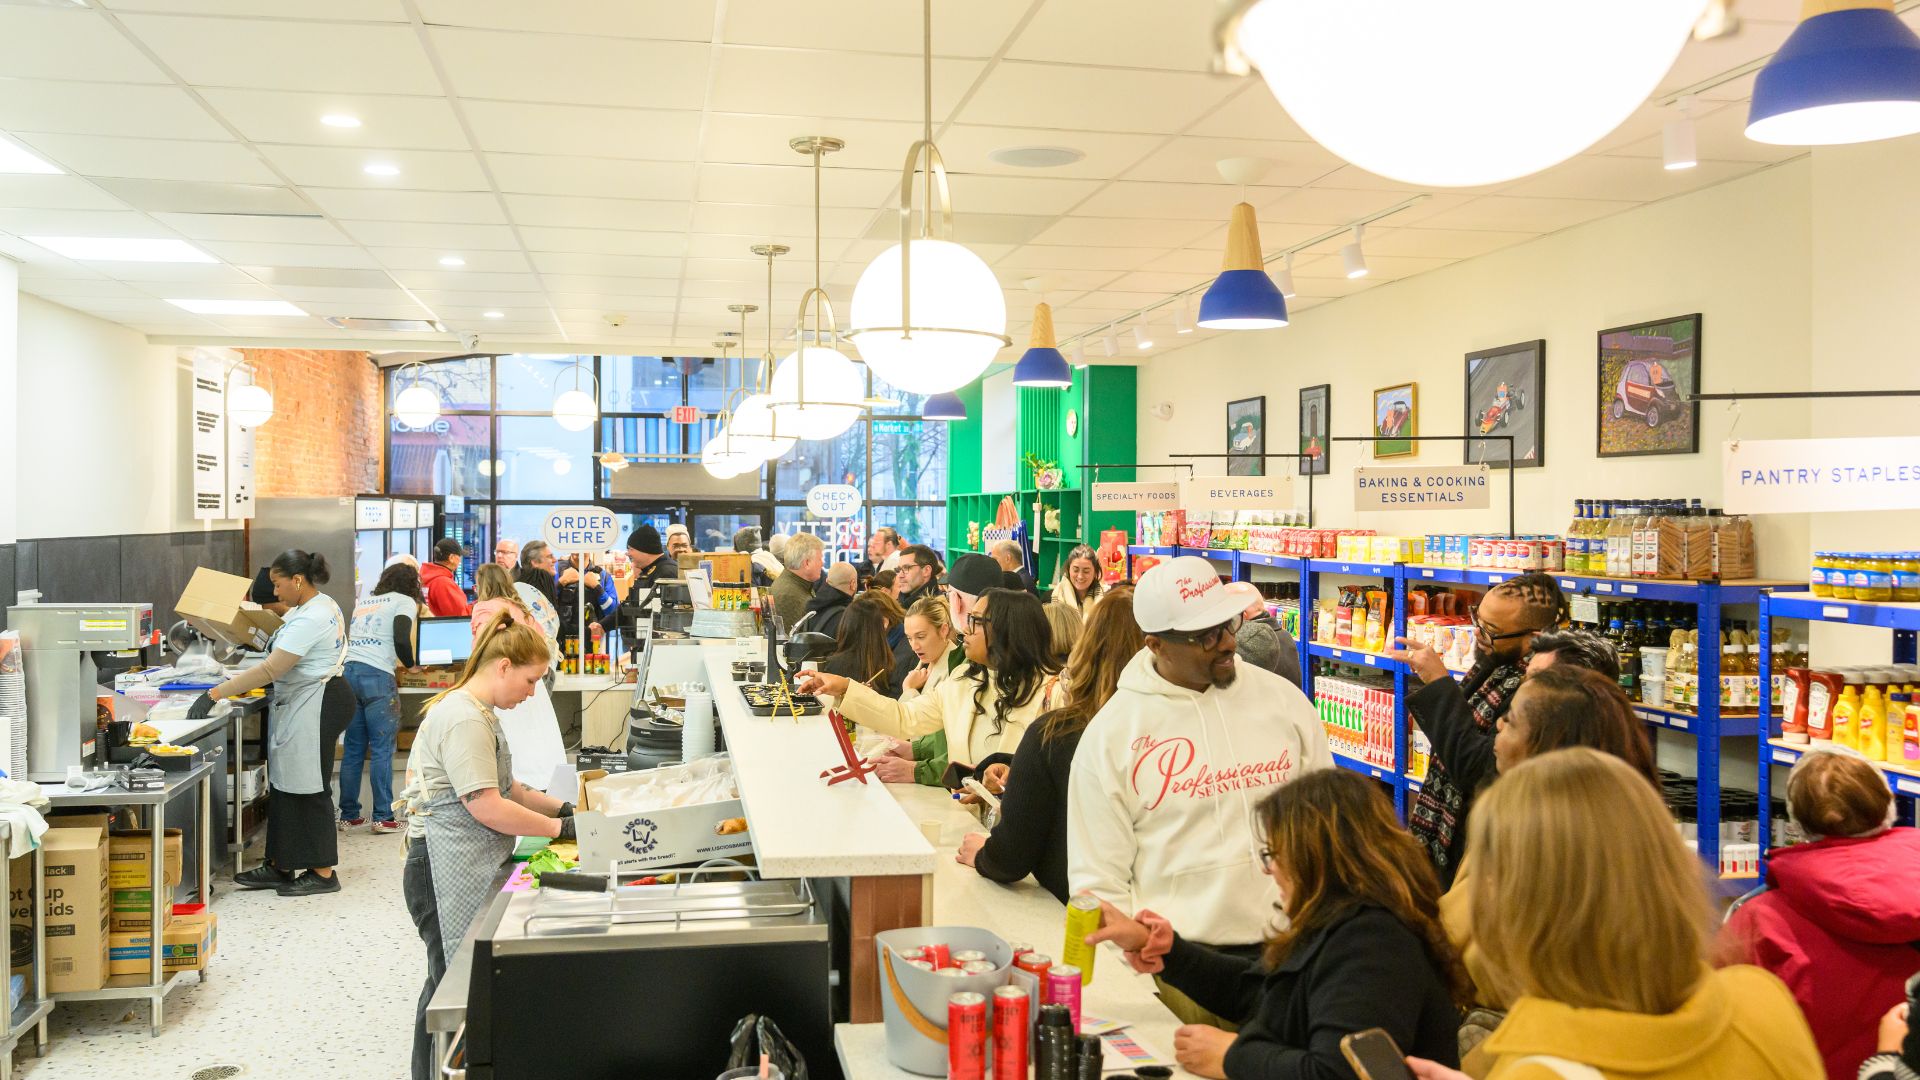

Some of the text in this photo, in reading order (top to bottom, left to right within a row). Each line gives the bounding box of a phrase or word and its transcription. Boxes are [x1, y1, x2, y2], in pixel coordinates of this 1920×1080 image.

[676, 407, 697, 423] EXIT
[879, 423, 901, 431] Market
[1359, 476, 1485, 488] BAKING & COOKING
[1741, 465, 1920, 486] PANTRY STAPLES
[814, 491, 854, 501] CHECK
[1096, 492, 1176, 500] SPECIALTY FOODS
[1210, 489, 1274, 498] BEVERAGES
[1381, 491, 1464, 503] ESSENTIALS
[822, 502, 847, 511] OUT
[551, 516, 612, 529] ORDER
[558, 531, 606, 544] HERE
[1175, 576, 1193, 588] The
[1131, 734, 1157, 752] The
[1132, 737, 1293, 811] Professionals
[1197, 772, 1290, 800] SERVICES, LLC
[622, 817, 659, 836] LISCIO'S
[623, 837, 659, 855] BAKERY
[45, 866, 67, 876] lack
[45, 902, 74, 917] ids
